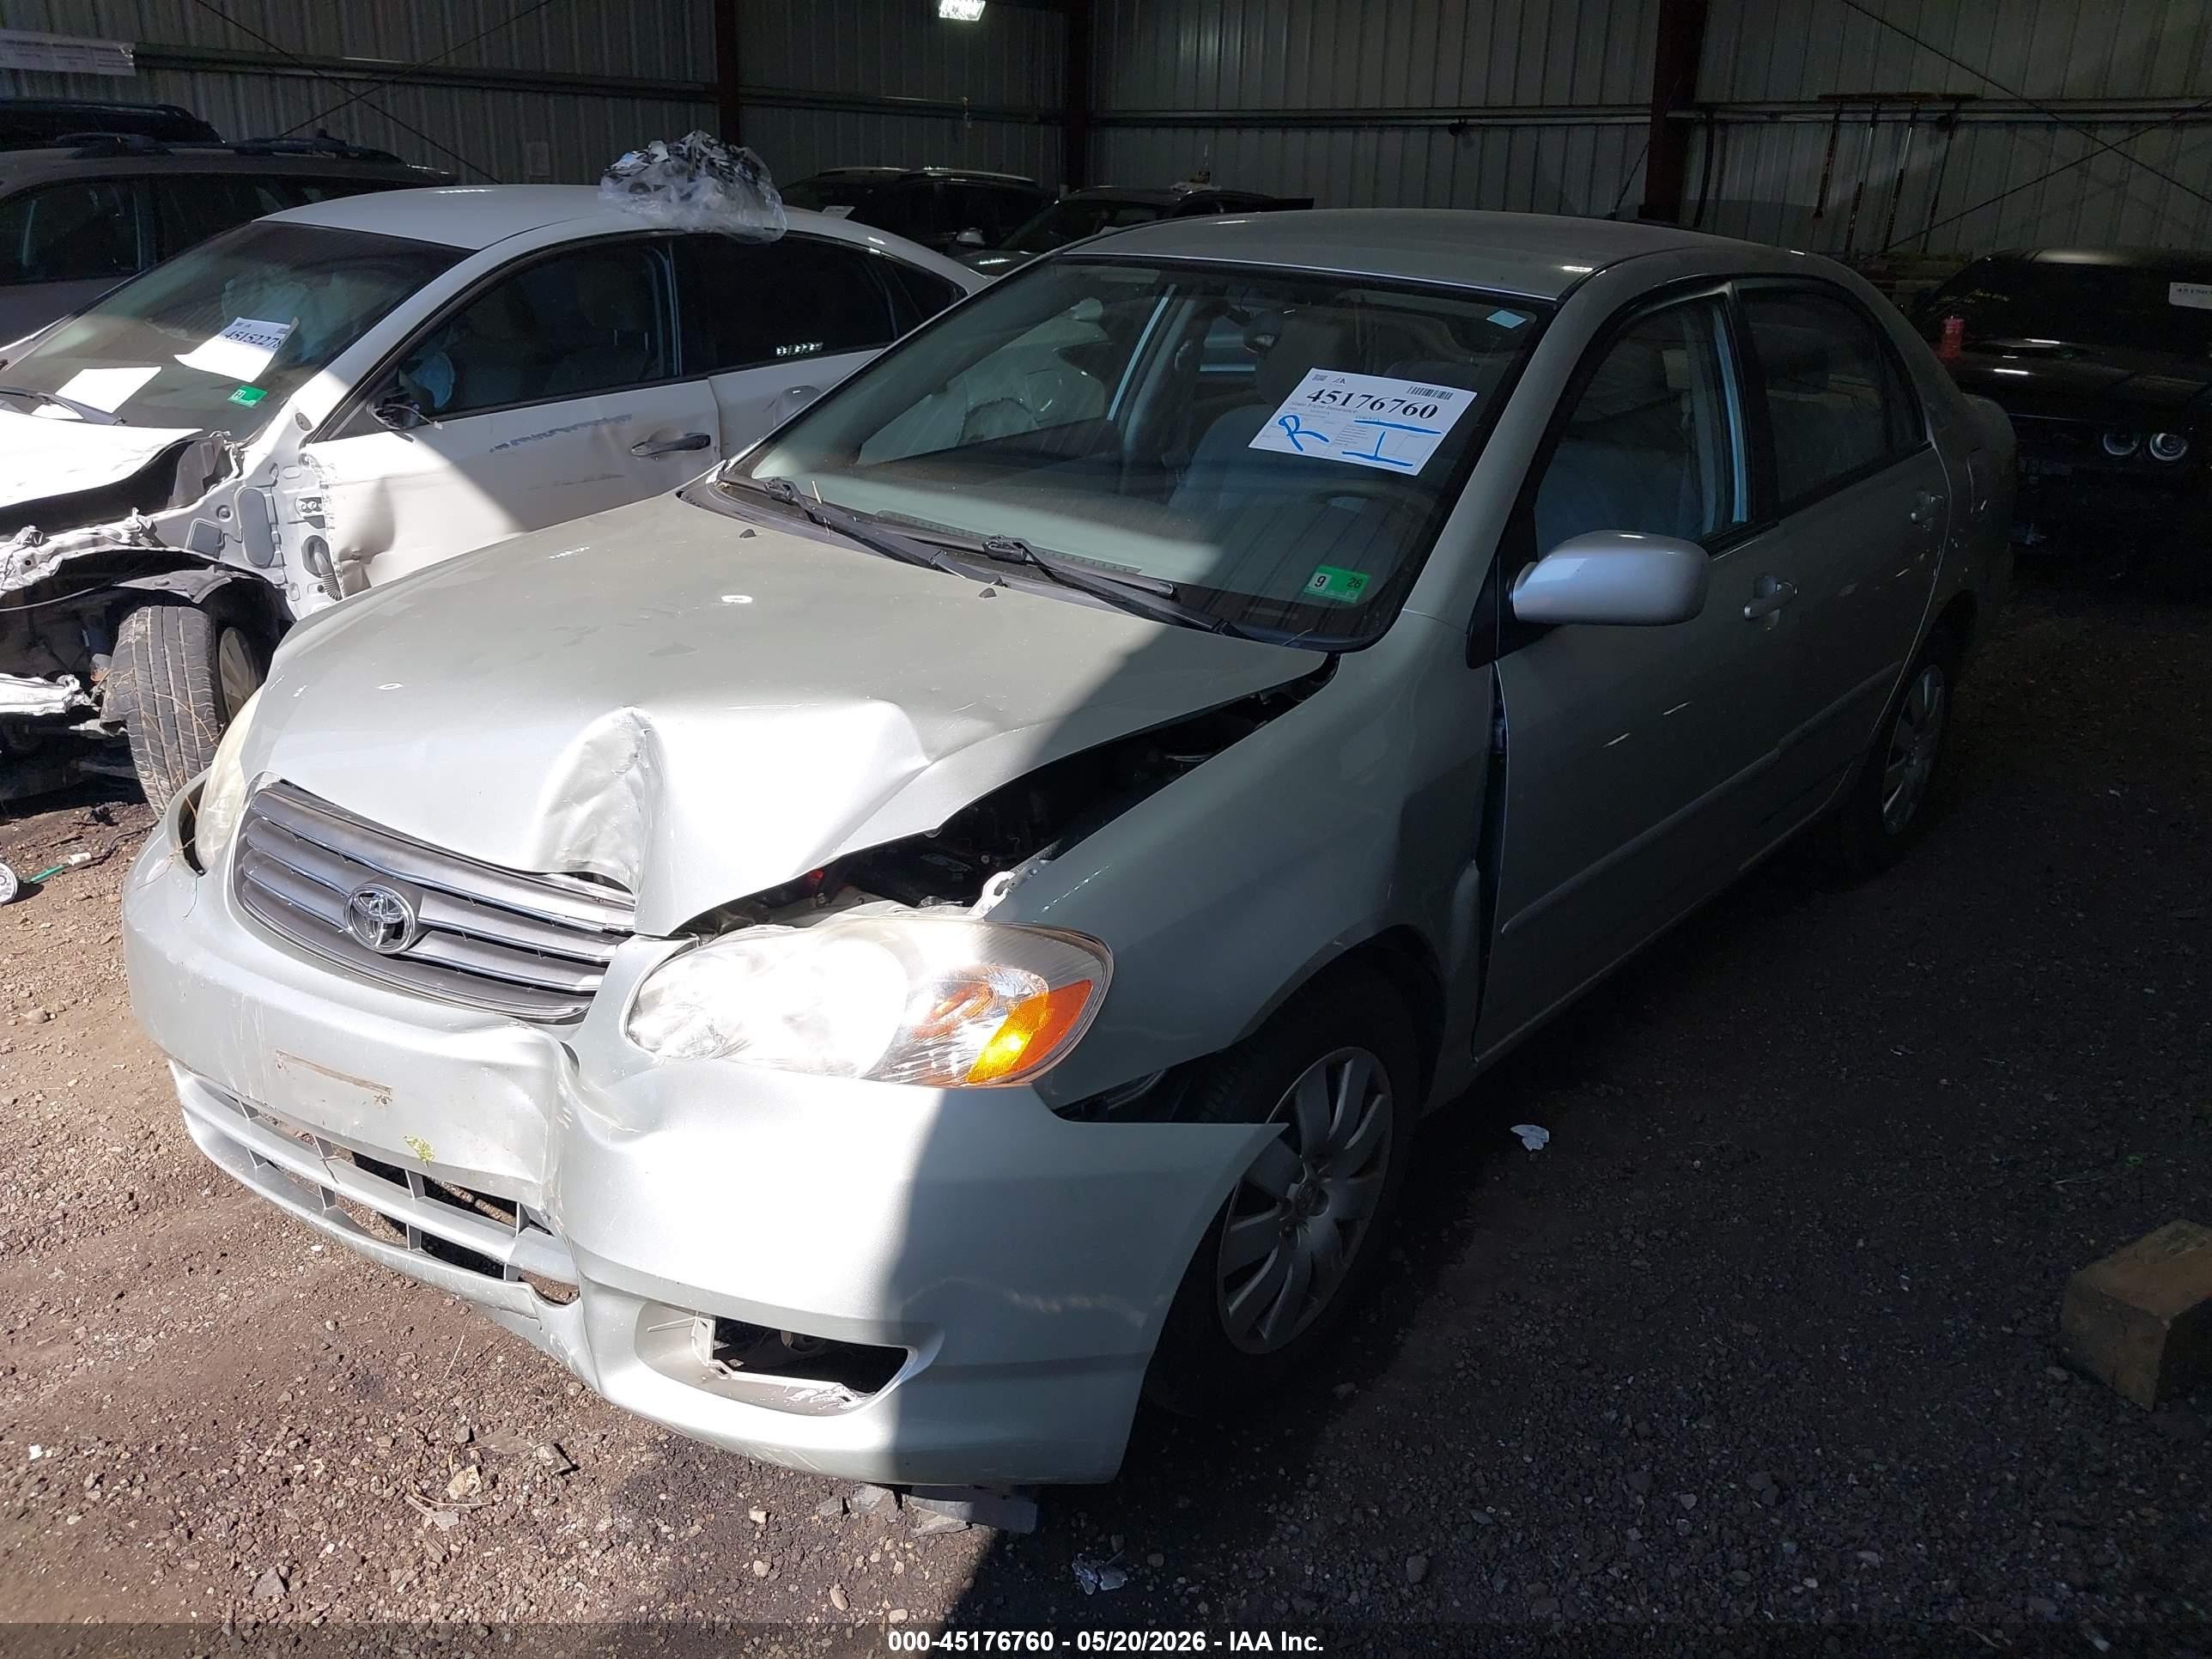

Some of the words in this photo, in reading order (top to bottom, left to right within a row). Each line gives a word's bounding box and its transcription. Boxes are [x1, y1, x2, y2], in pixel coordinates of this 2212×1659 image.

[1306, 388, 1439, 420] 45176760
[1278, 414, 1330, 452] R
[1315, 575, 1327, 588] 9
